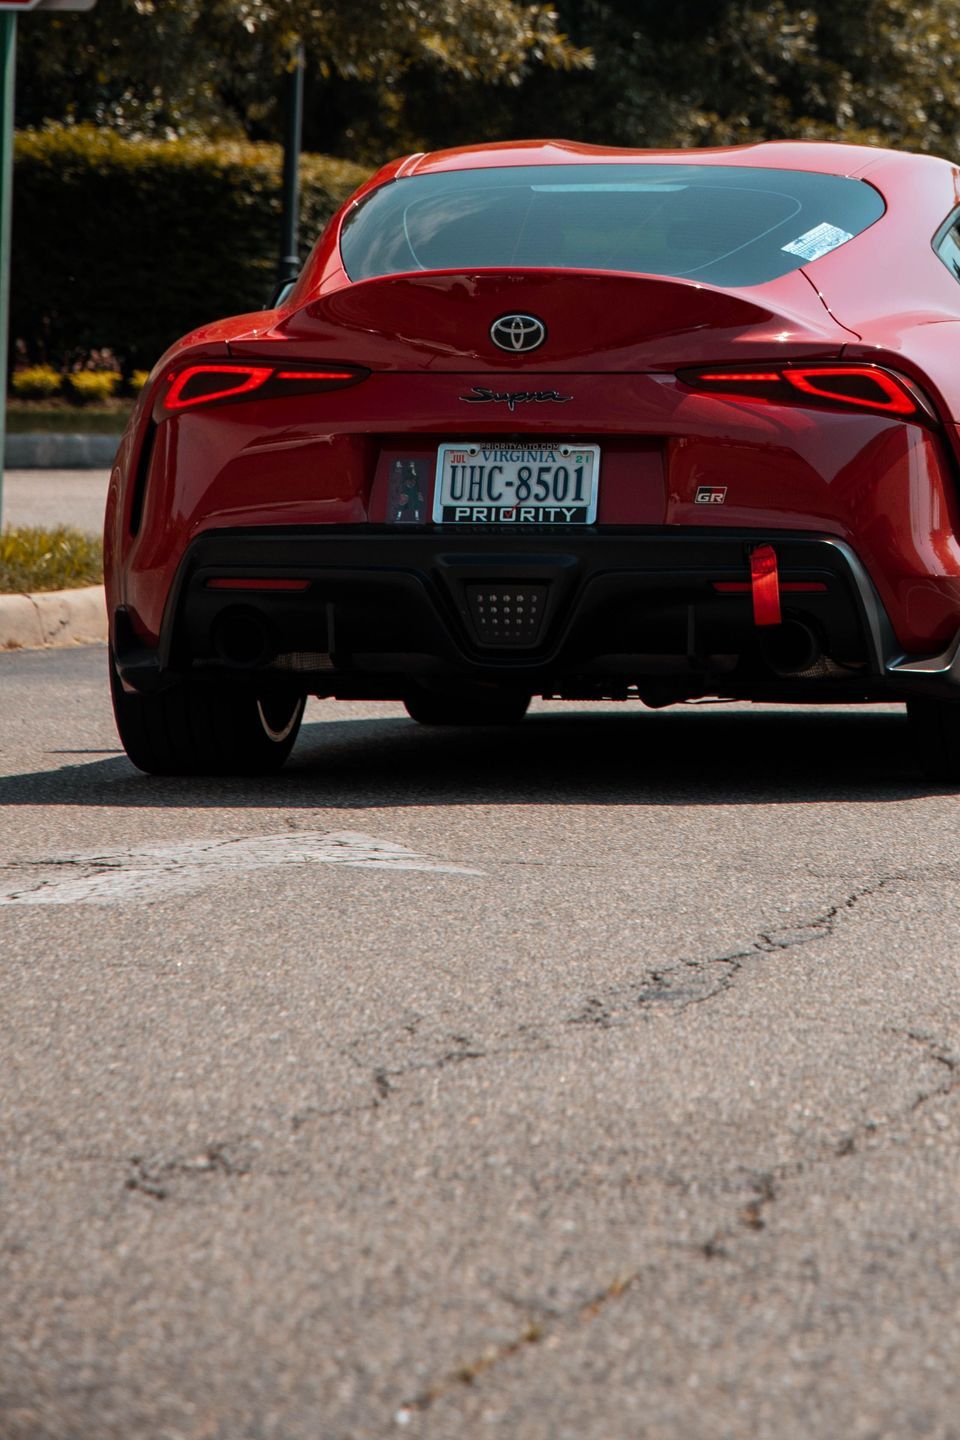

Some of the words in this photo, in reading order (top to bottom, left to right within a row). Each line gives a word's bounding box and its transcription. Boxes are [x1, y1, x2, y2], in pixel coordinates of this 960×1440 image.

[459, 387, 573, 411] Supra
[450, 455, 465, 464] JUL
[482, 450, 557, 462] VIRGINIA
[450, 465, 584, 502] UHC-8501
[698, 493, 723, 502] GR
[455, 508, 577, 522] PRIORITY
